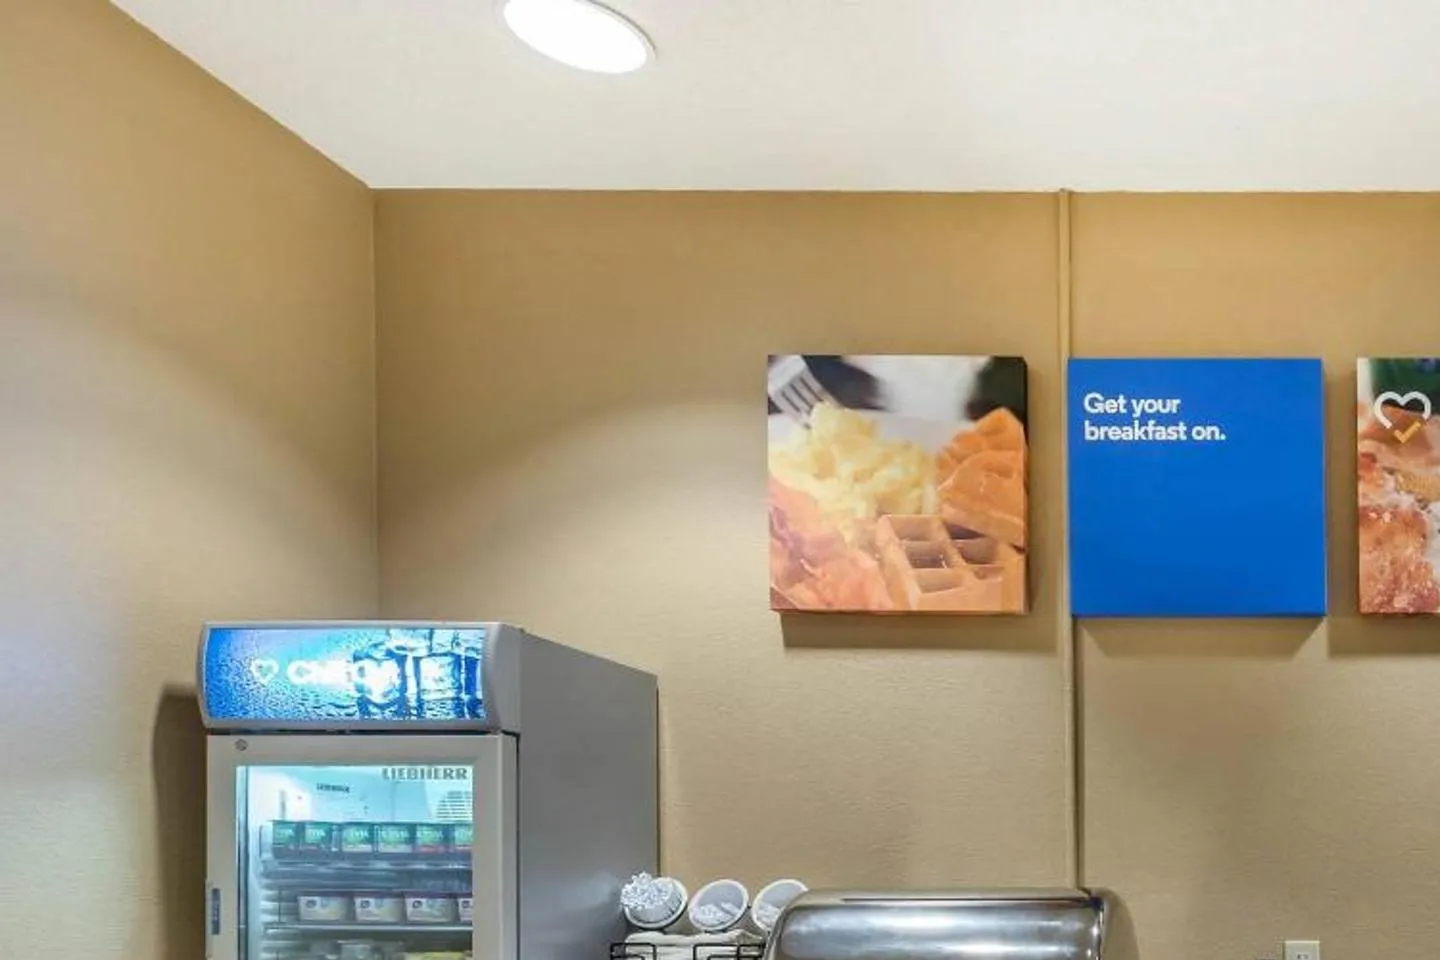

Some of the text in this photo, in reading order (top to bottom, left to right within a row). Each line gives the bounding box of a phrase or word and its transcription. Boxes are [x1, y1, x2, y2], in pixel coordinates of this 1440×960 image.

[1084, 392, 1181, 418] Get your
[1084, 420, 1226, 441] breakfast on.
[382, 767, 468, 781] LIEBHERR
